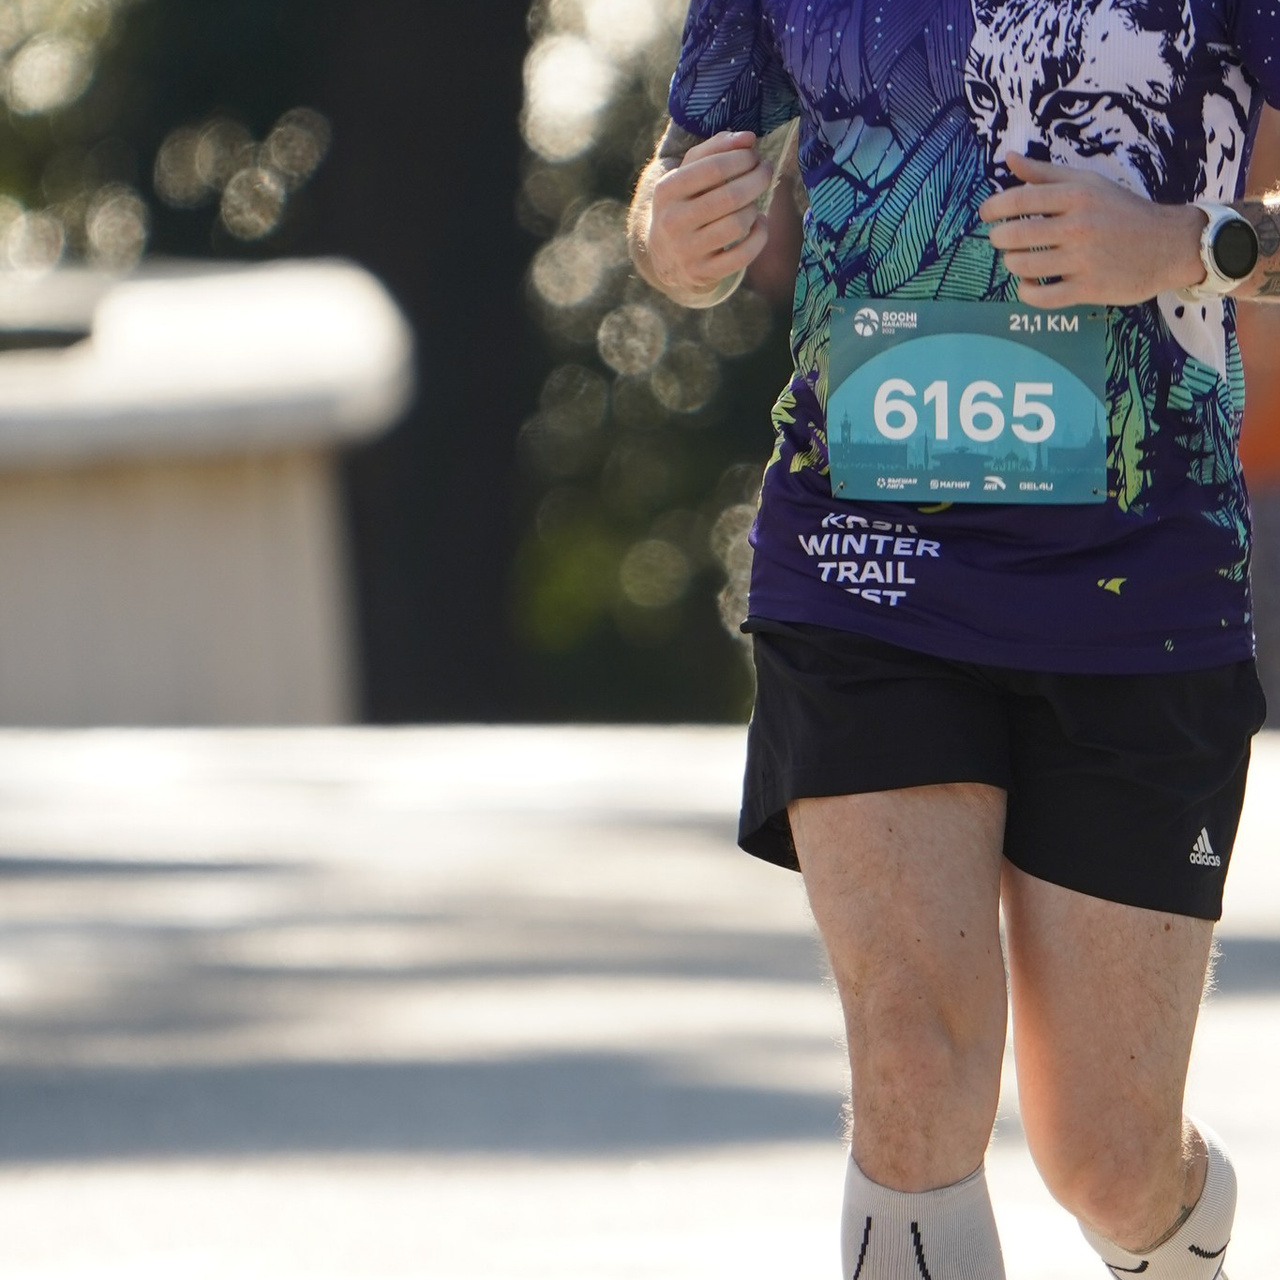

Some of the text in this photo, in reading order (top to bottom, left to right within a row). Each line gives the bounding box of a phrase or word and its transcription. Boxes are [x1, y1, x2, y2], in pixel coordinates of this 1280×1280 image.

[881, 320, 917, 329] MARATHON
[882, 311, 917, 322] SOCHI
[1009, 313, 1079, 334] 21,1 KM
[873, 378, 1056, 443] 6165
[940, 481, 971, 490] МАГНИТ
[798, 533, 941, 557] WINTER
[817, 560, 916, 584] TRAIL
[1189, 851, 1221, 867] adidas
